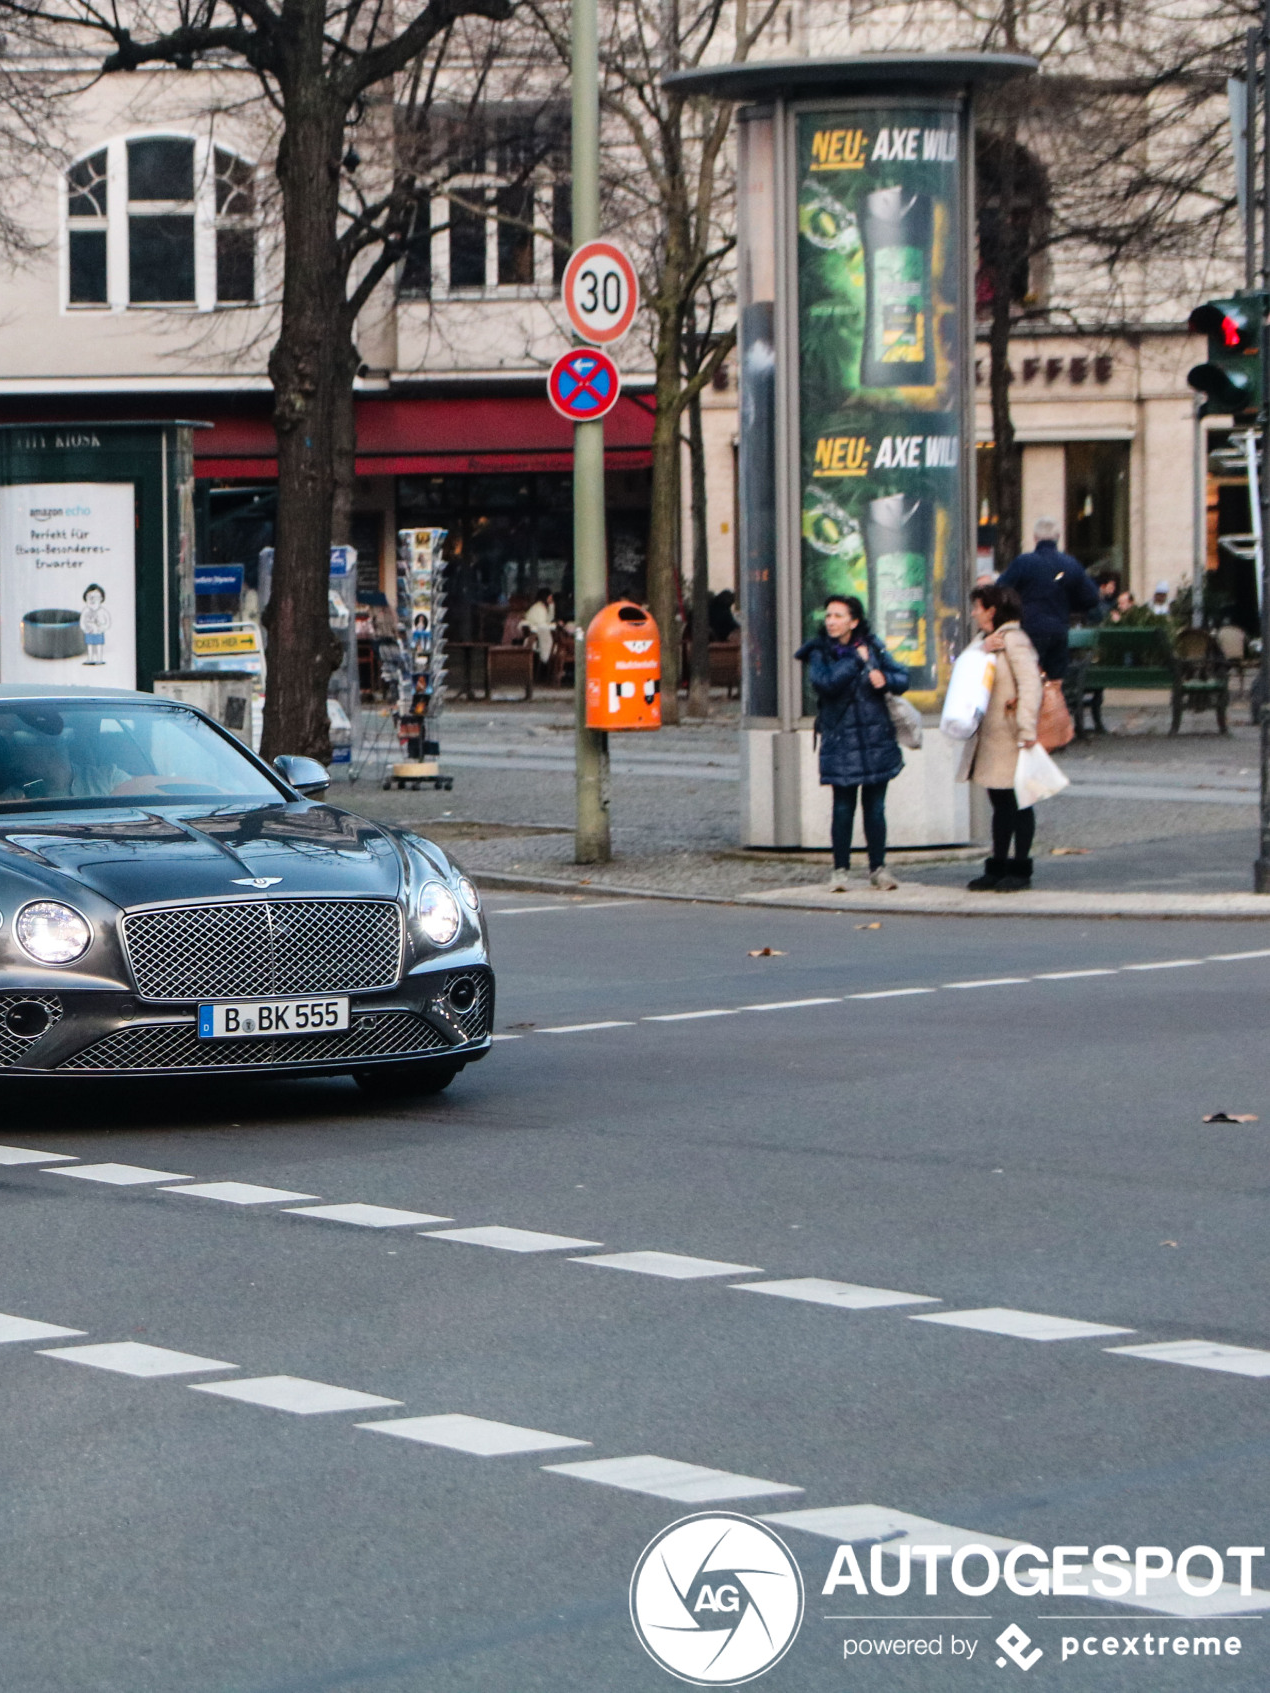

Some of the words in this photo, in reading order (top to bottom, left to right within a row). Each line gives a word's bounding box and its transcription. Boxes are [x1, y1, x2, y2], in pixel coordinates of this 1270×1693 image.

[812, 129, 868, 163] NEU:
[871, 128, 920, 161] AXE
[581, 270, 621, 314] 30
[55, 433, 101, 449] KIOSK
[814, 436, 872, 470] NEU:
[874, 435, 923, 468] AXE
[30, 508, 63, 518] amazon
[65, 505, 91, 517] echo
[30, 529, 67, 540] Perfekt
[71, 528, 89, 540] für
[36, 559, 84, 569] Erwarter
[225, 1008, 240, 1032] B
[258, 1005, 289, 1030] BK
[295, 1001, 339, 1028] 555
